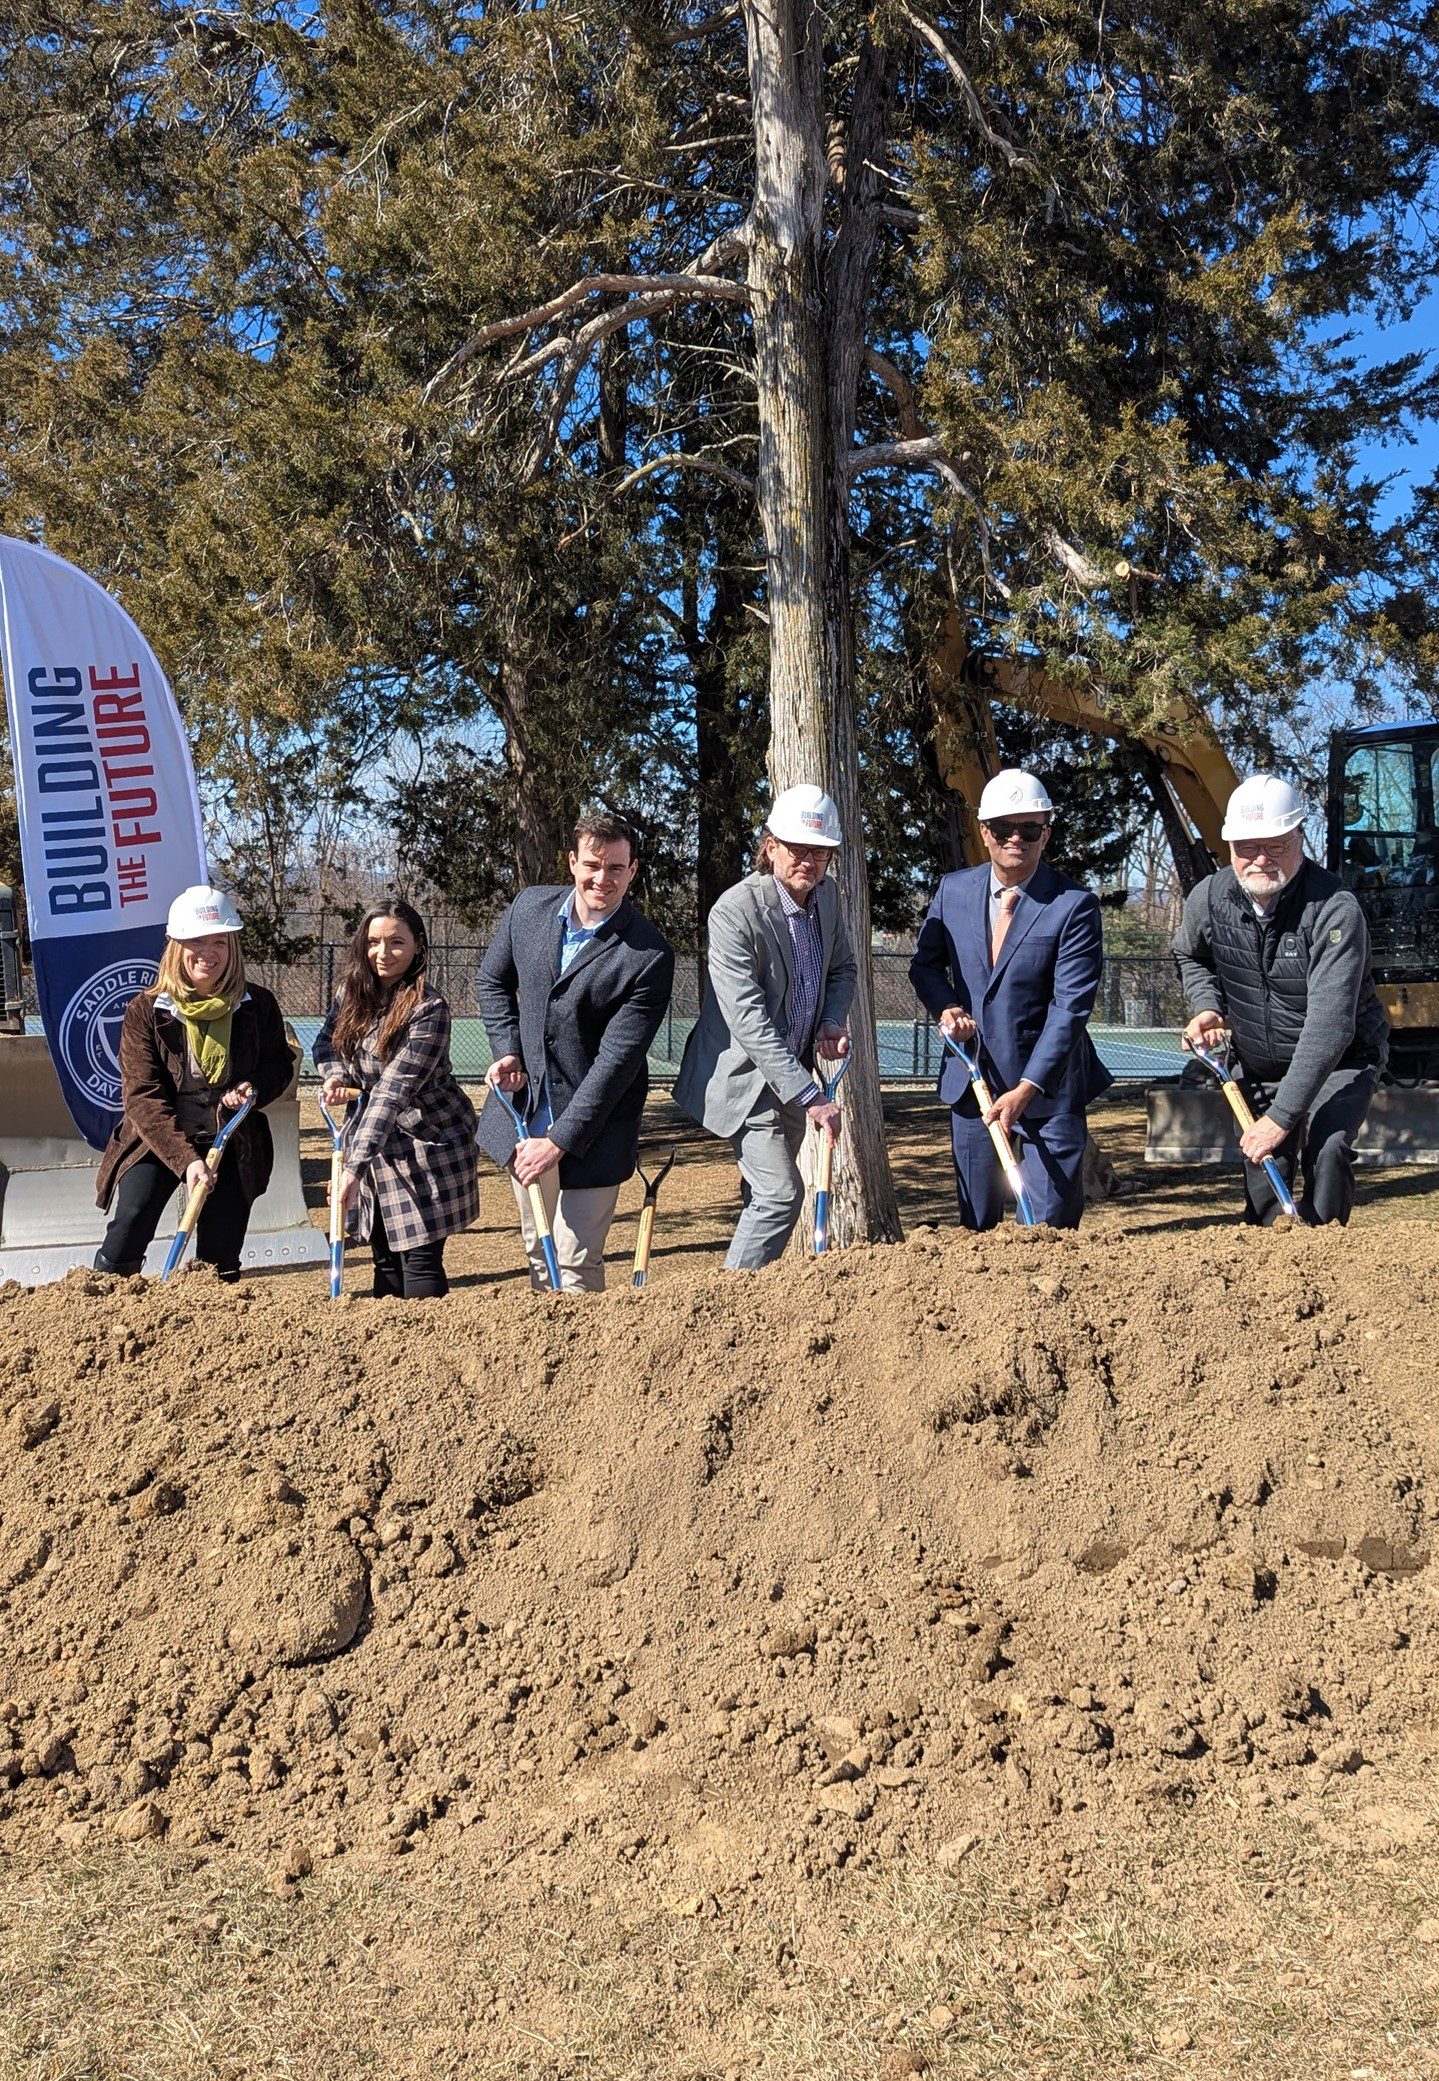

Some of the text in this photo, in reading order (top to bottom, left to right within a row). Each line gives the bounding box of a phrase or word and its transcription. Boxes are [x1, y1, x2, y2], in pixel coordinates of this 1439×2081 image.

[28, 666, 112, 915] BUILDING
[88, 662, 162, 909] THE FUTURE
[76, 970, 137, 1023] SADDLE
[86, 1073, 119, 1098] DAY
